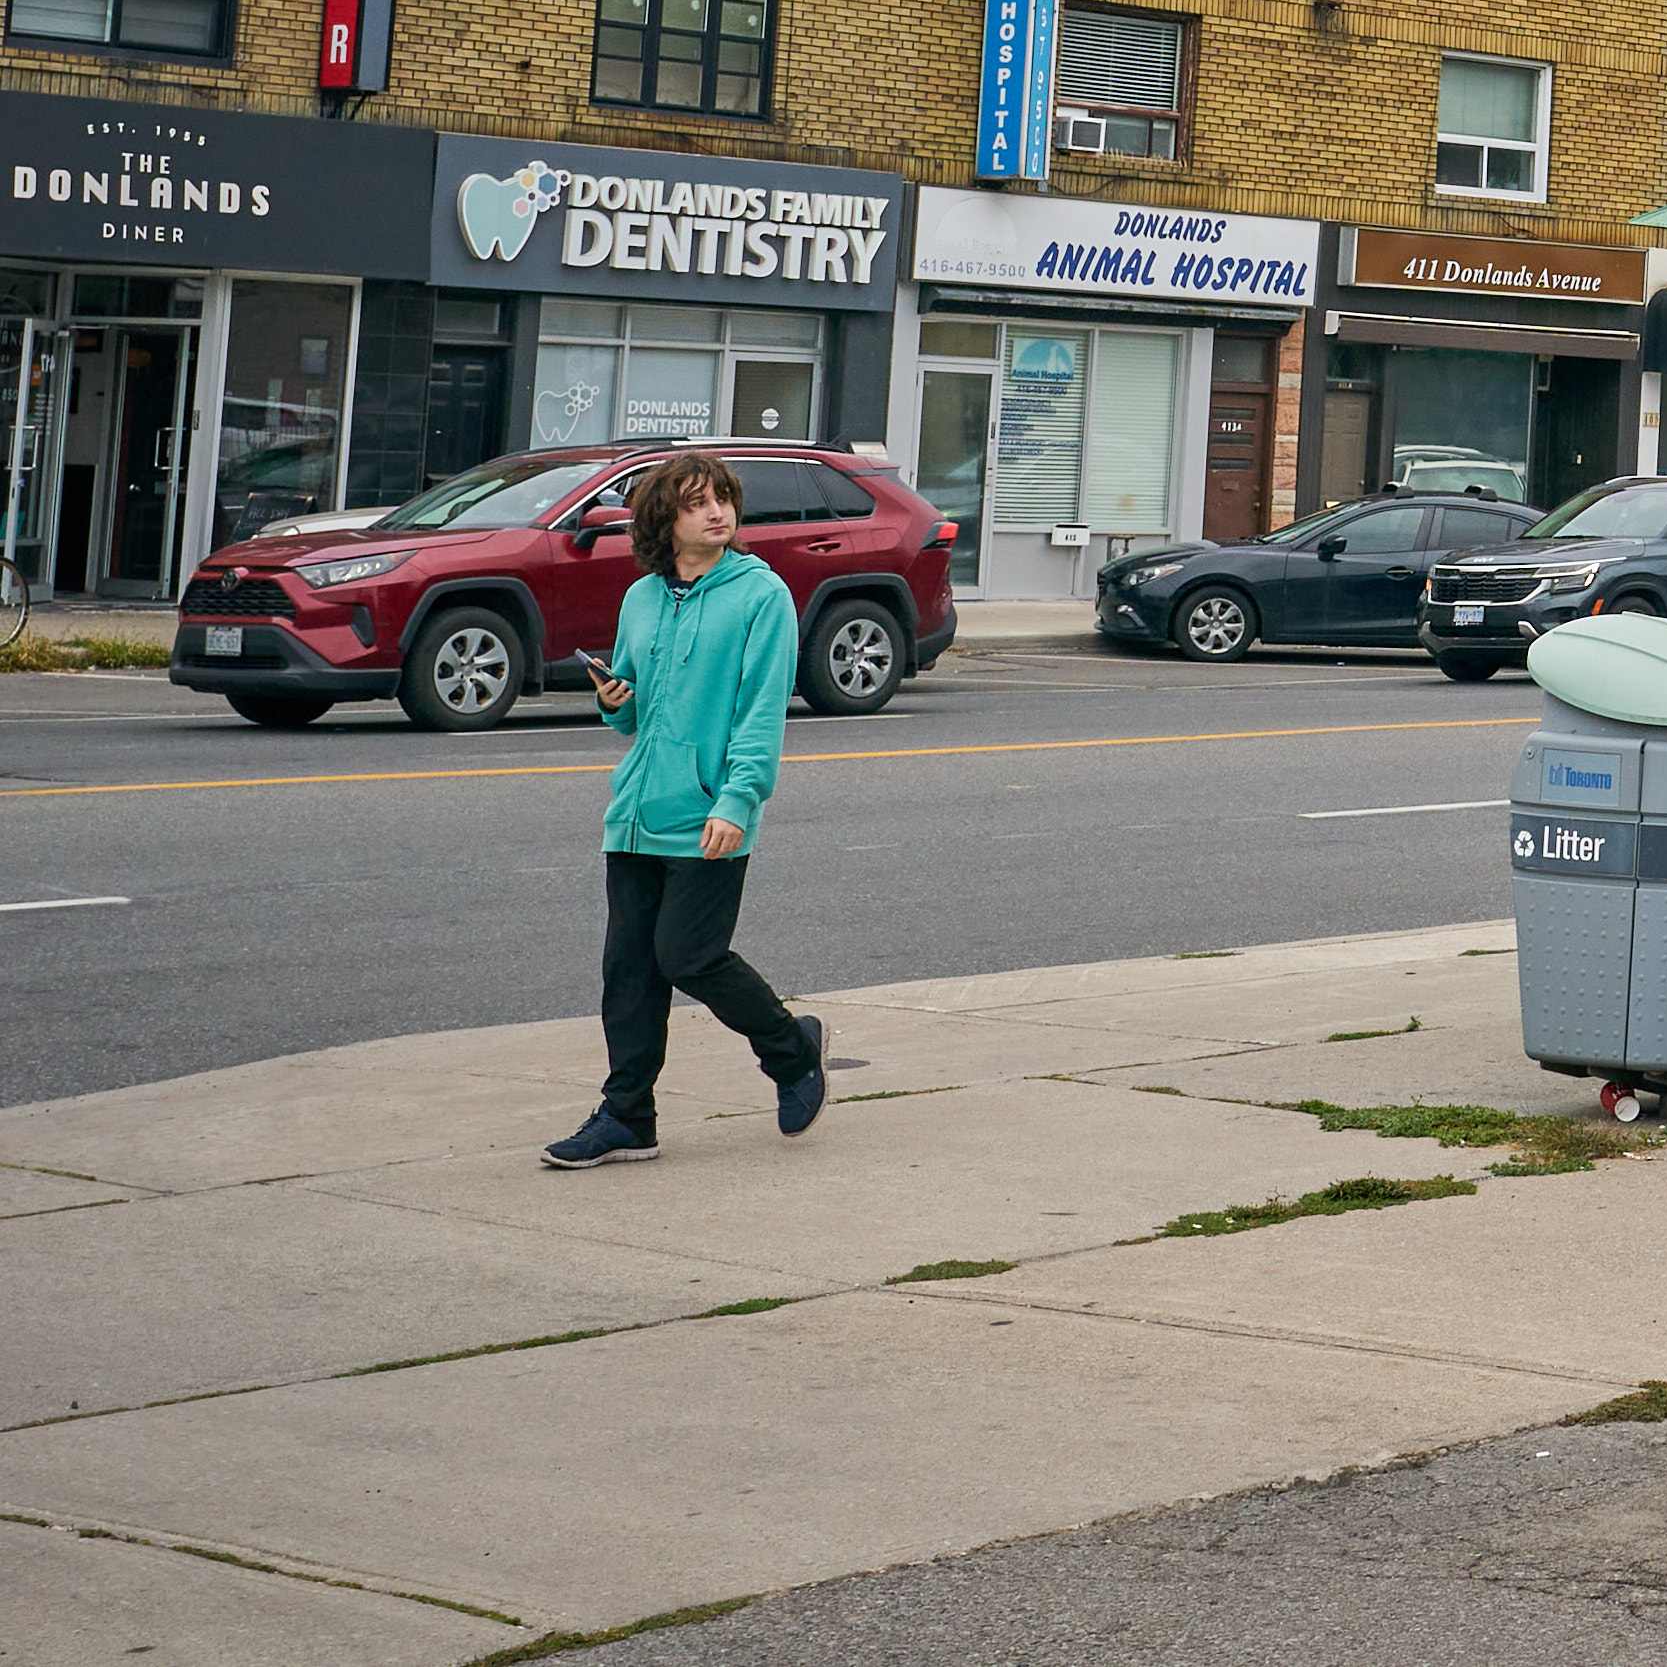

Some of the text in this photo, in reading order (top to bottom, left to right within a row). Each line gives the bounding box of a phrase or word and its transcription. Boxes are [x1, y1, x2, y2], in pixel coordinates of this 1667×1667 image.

[992, 2, 1017, 170] HOSPITAL
[87, 122, 136, 135] EST.
[122, 152, 171, 175] THE
[13, 166, 271, 217] DONLANDS
[567, 173, 889, 229] DONLANDS FAMILY
[102, 222, 185, 244] DINER
[1113, 211, 1227, 244] DONLANDS
[562, 209, 887, 284] DENTISTRY
[920, 259, 1026, 278] 416-467-9500
[1036, 241, 1157, 286] ANIMAL
[1171, 252, 1308, 298] HOSPITAL
[1403, 257, 1602, 292] 411 Donlands Avenue
[1012, 369, 1074, 382] Animal Hospital
[628, 400, 710, 417] DONLANDS
[626, 417, 709, 434] DENTISTRY
[1565, 767, 1612, 790] TORONTO
[1542, 825, 1605, 863] Litter
